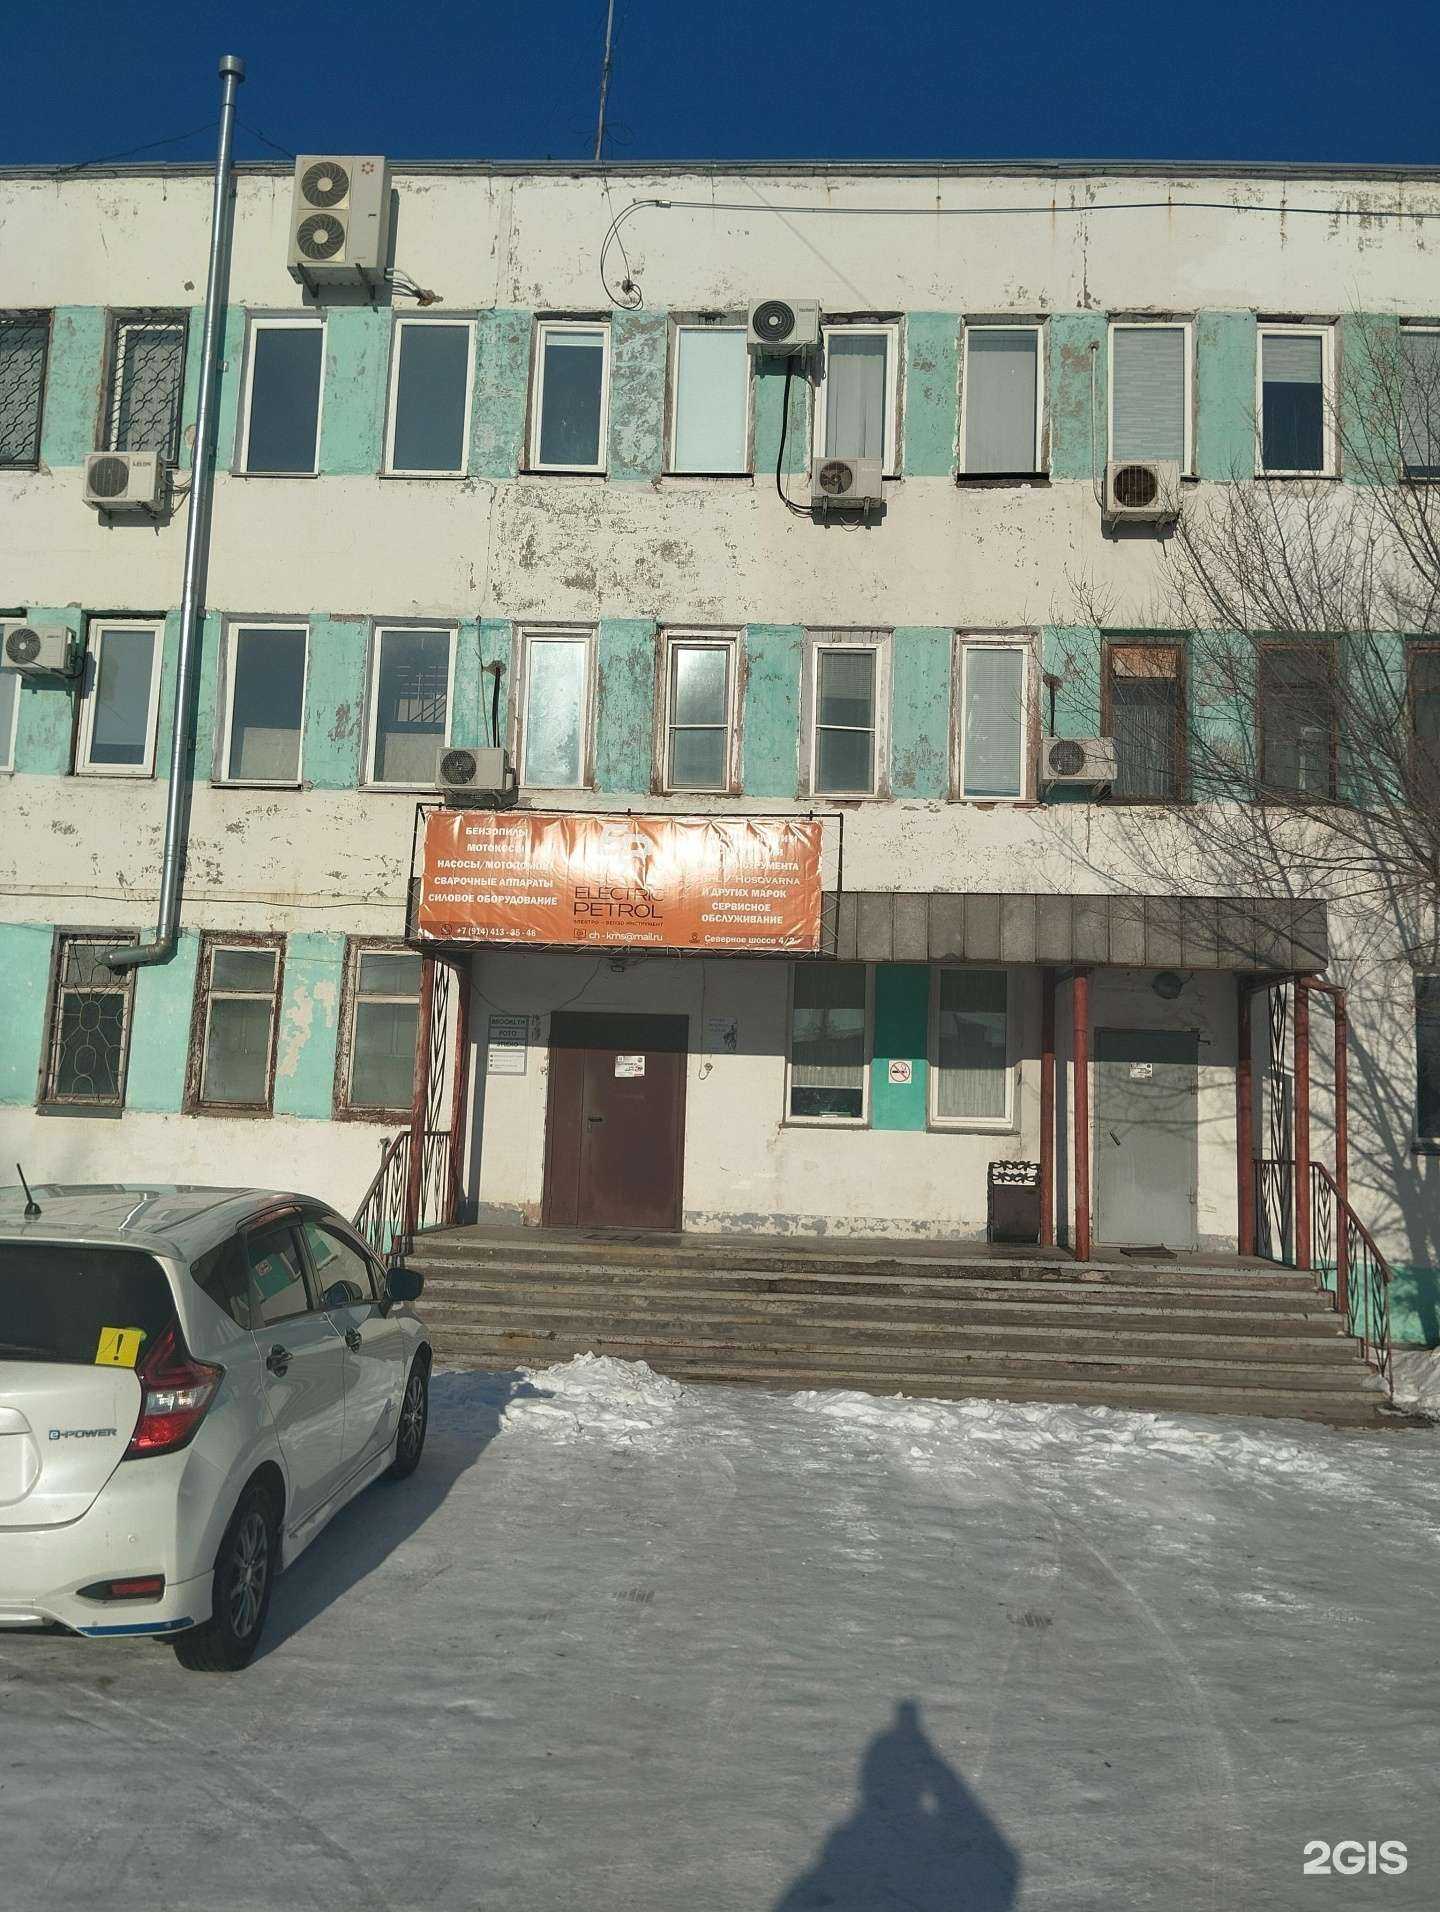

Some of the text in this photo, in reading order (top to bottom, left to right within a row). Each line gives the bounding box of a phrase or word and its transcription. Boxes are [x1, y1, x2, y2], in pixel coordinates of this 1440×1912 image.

[465, 827, 529, 837] БЕНЗОПИЛЫ
[434, 876, 554, 889] СВАРОЧНЫЕ АППАРАТЫ
[736, 876, 801, 885] HUSQVARNA
[574, 886, 664, 902] ELECTRIC
[711, 888, 749, 897] ДРУГИХ
[751, 889, 787, 898] МАРОК
[428, 893, 559, 906] СИЛОВОЕ ОБОРУДОВАНИЕ
[573, 902, 663, 919] PETROL
[712, 902, 772, 912] СЕРВИСНОЕ
[701, 914, 784, 925] ОБСЛУЖИВАНИЕ
[468, 927, 489, 937] (914)
[490, 928, 505, 936] 413
[588, 930, 600, 939] ch
[606, 931, 664, 943] kms@mail.ru
[704, 934, 747, 944] Северное
[748, 937, 777, 945] шоссе
